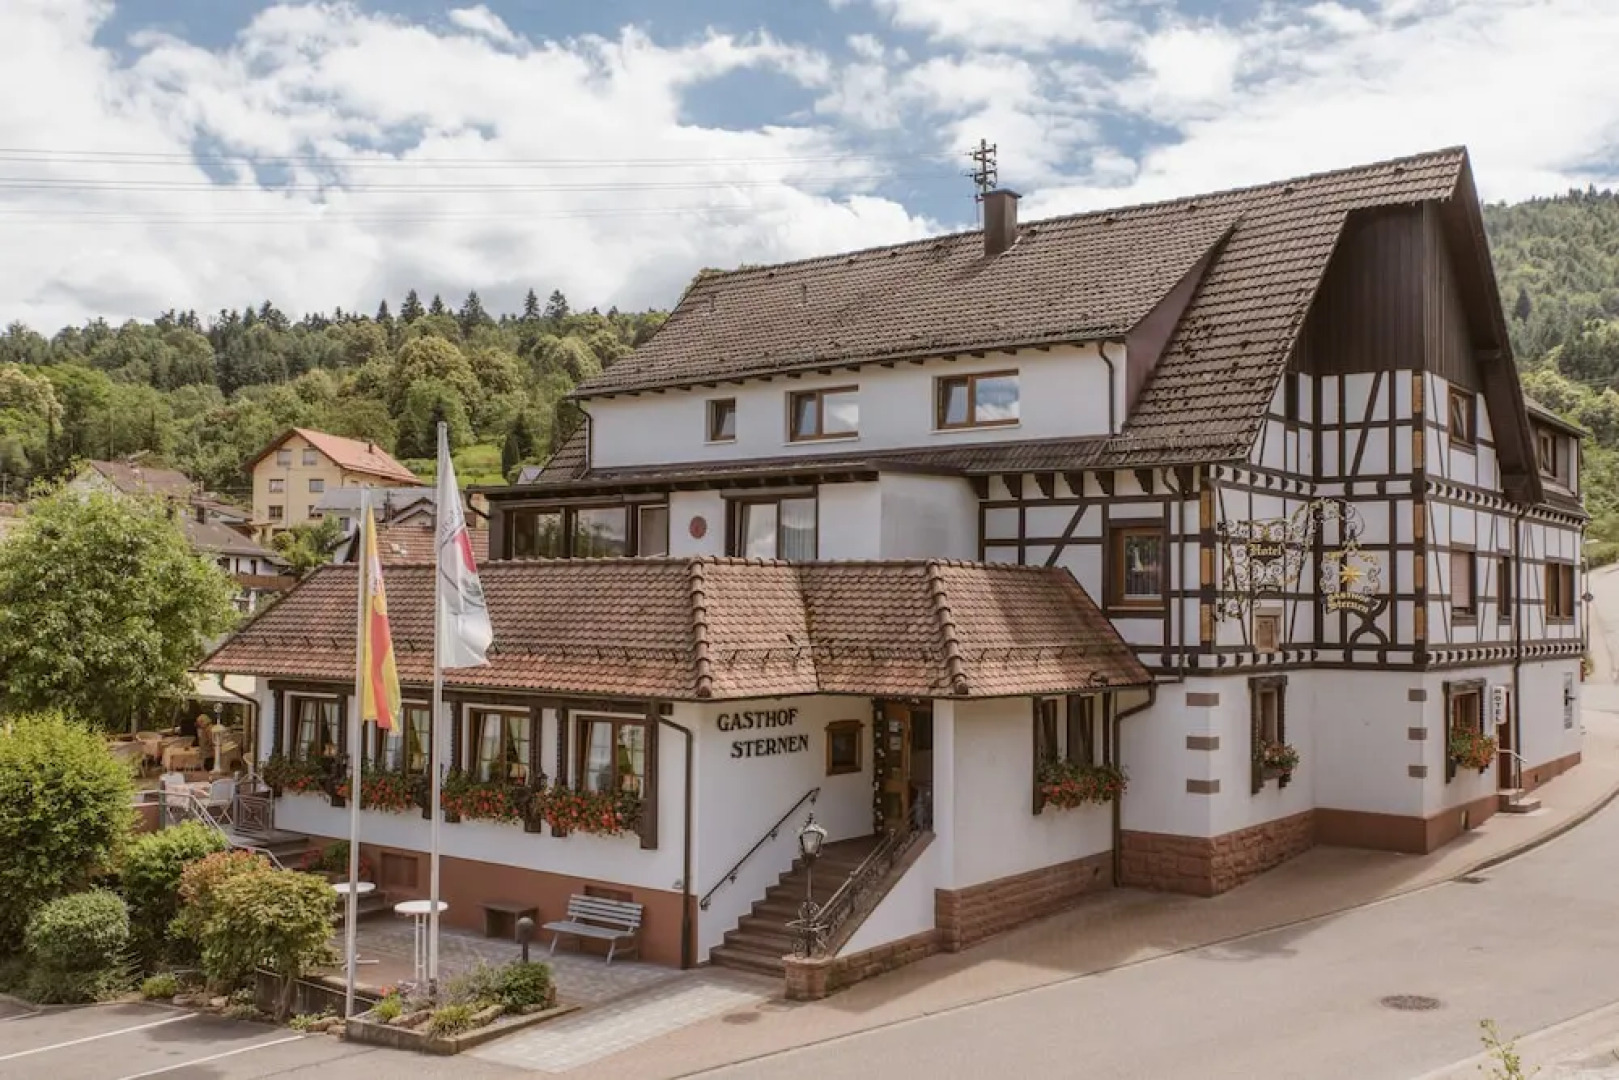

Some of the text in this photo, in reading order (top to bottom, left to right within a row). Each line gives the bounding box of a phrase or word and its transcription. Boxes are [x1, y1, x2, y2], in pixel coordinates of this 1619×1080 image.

[1250, 543, 1282, 556] Hotel
[1494, 688, 1502, 722] HOTEL
[717, 708, 798, 731] GASTHOF
[730, 735, 808, 758] STERNEN
